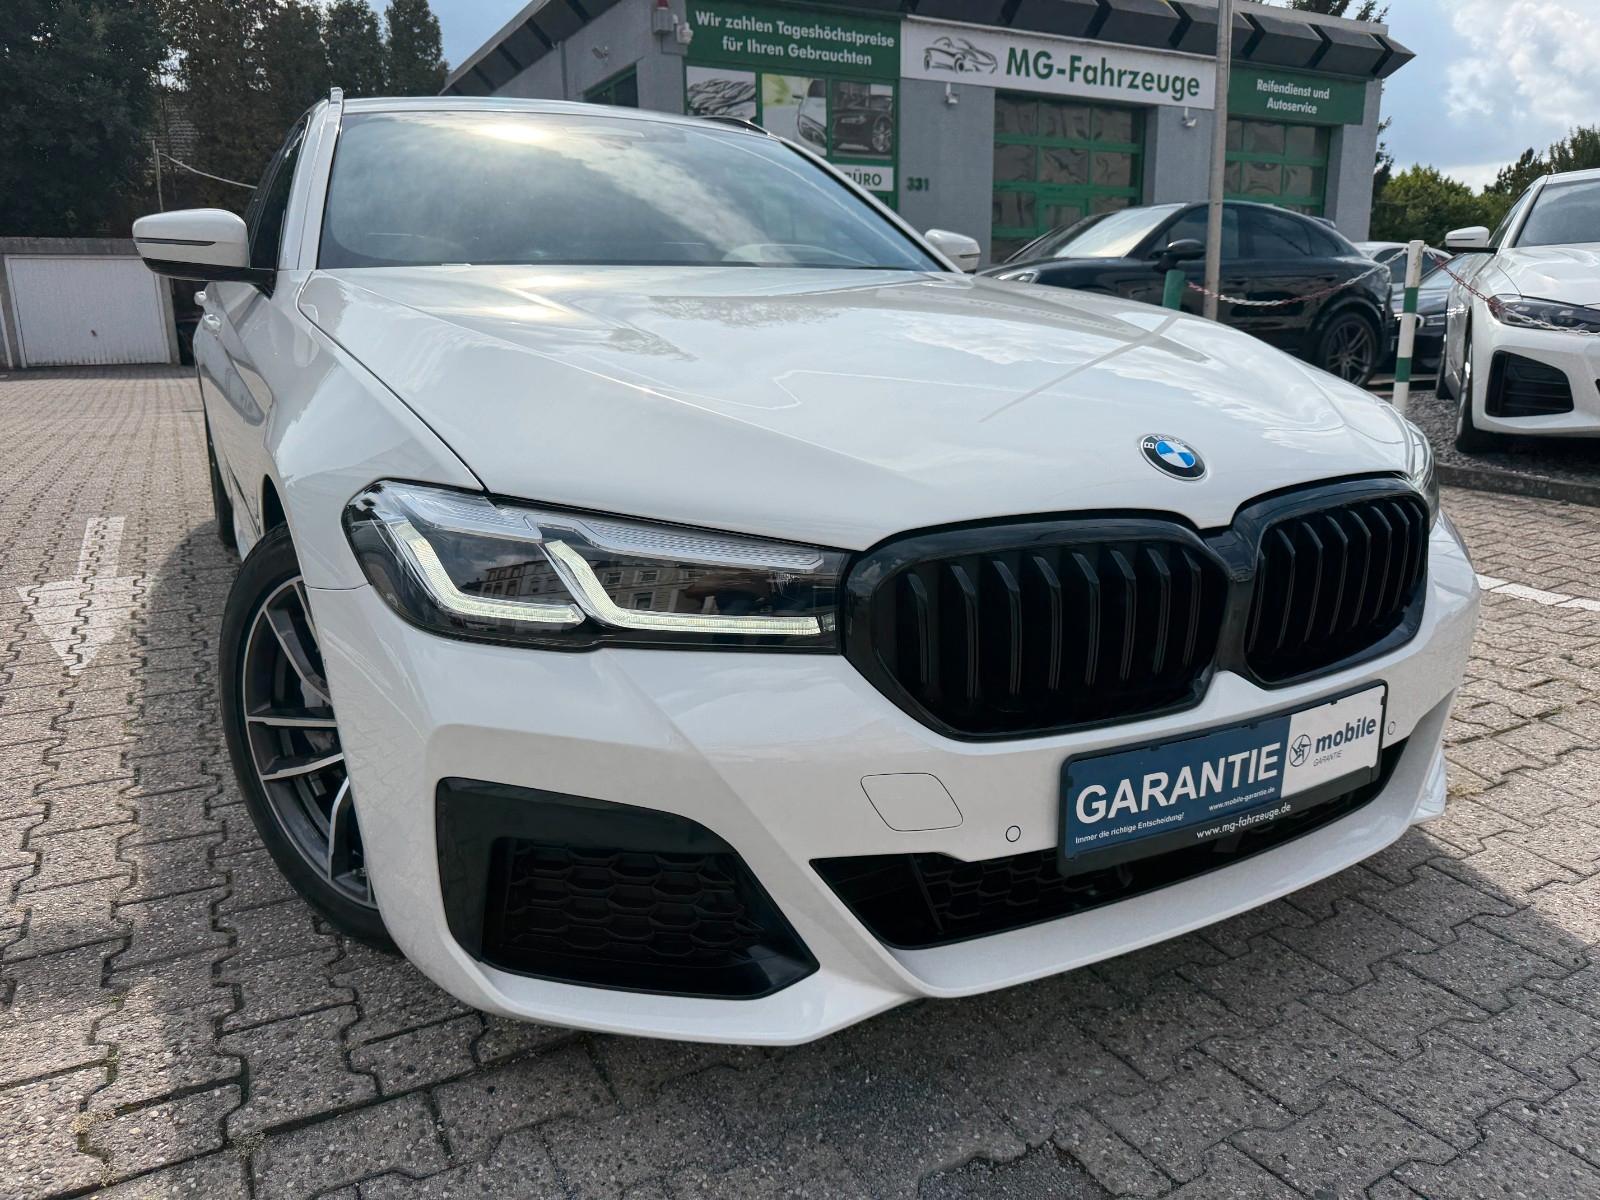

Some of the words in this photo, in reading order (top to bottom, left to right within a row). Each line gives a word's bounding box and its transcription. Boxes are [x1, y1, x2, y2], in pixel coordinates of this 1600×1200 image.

[695, 10, 722, 28] Wir
[725, 15, 773, 34] zahlen
[776, 20, 895, 48] Tageshöchstpreise
[722, 35, 744, 52] für
[747, 39, 784, 57] Ihren
[788, 43, 872, 66] Gebrauchten
[1006, 47, 1200, 101] MG-Fahrzeuge
[1256, 79, 1311, 97] Reifendienst
[1313, 87, 1330, 99] und
[1266, 96, 1318, 115] Autoservice
[1315, 716, 1377, 754] mobile
[1313, 750, 1343, 767] GARANTIE
[1075, 742, 1281, 824] GARANTIE
[1208, 786, 1276, 812] www.mobile-garantie.de
[1075, 832, 1098, 844] Immer
[1098, 828, 1110, 838] die
[1110, 823, 1137, 836] richtige
[1196, 802, 1292, 839] www.mg-fahrzeuge.de
